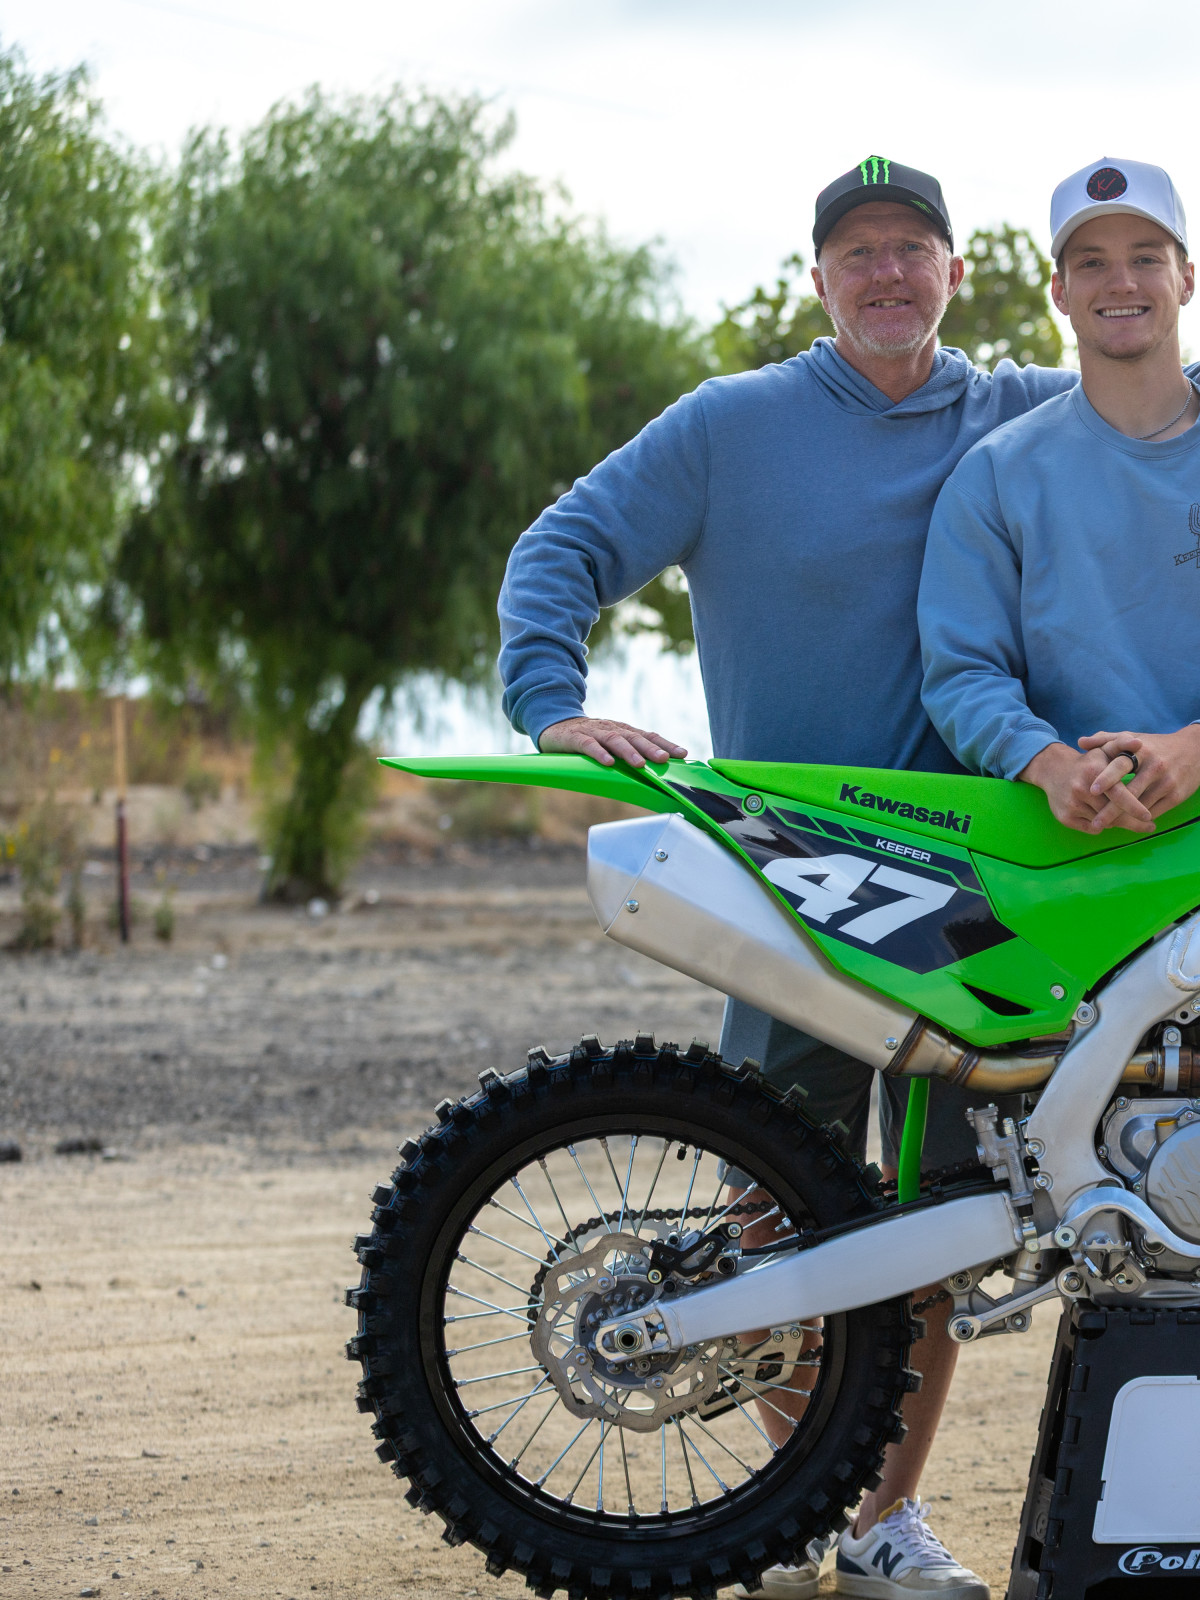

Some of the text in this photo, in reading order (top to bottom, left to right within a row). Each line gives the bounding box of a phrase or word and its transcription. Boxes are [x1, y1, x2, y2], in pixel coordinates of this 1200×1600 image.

[839, 783, 972, 834] Kawasaki
[875, 838, 932, 863] KEEFER
[761, 853, 958, 945] 47
